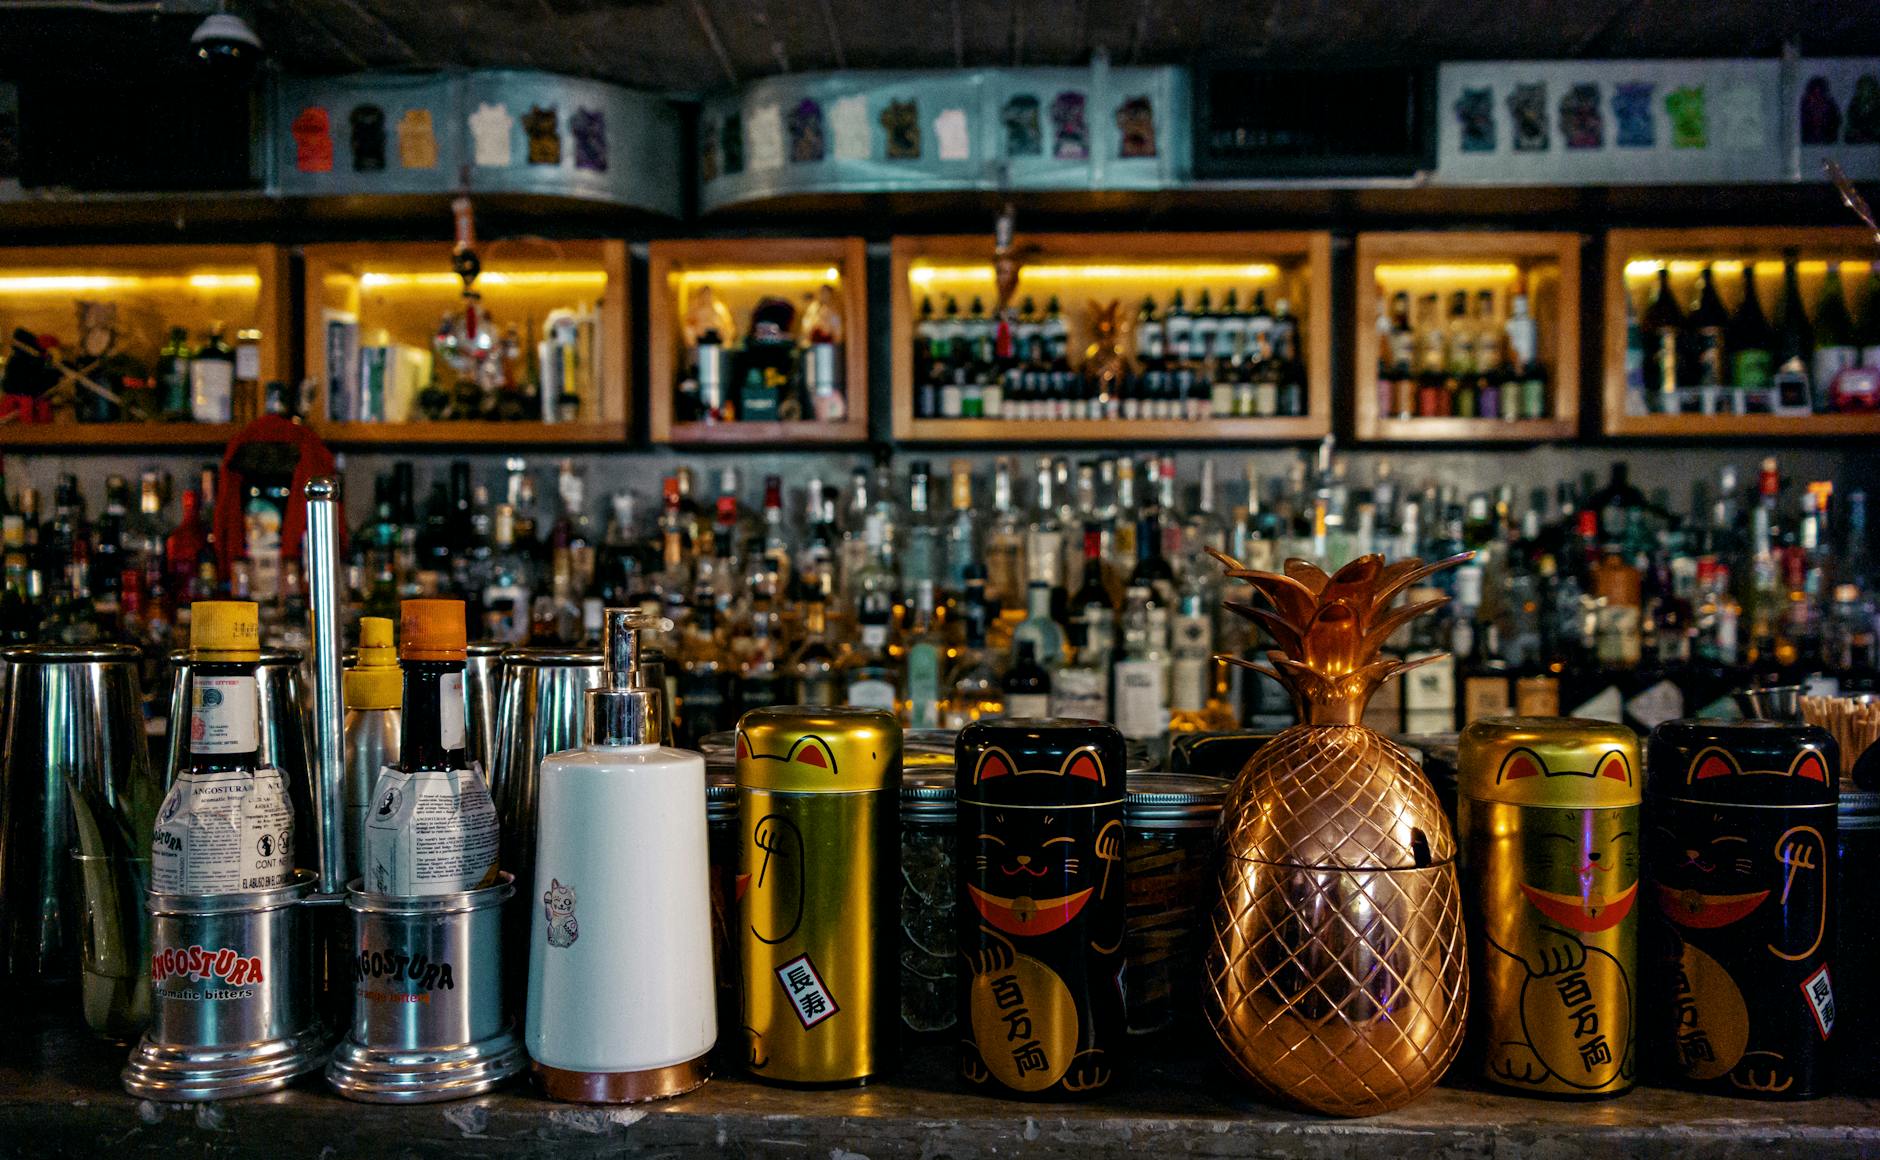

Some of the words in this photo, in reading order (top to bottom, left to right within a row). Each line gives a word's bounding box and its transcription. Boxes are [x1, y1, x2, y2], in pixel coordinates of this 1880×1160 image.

[255, 859, 277, 869] CONT
[152, 945, 263, 987] ANGOSTURA
[352, 948, 454, 991] NGOSTURA
[160, 988, 200, 1000] romatic
[205, 988, 252, 1000] bitters
[787, 965, 826, 1018] 長寿
[991, 975, 1049, 1078] 百万両
[1555, 971, 1613, 1073] 百万両
